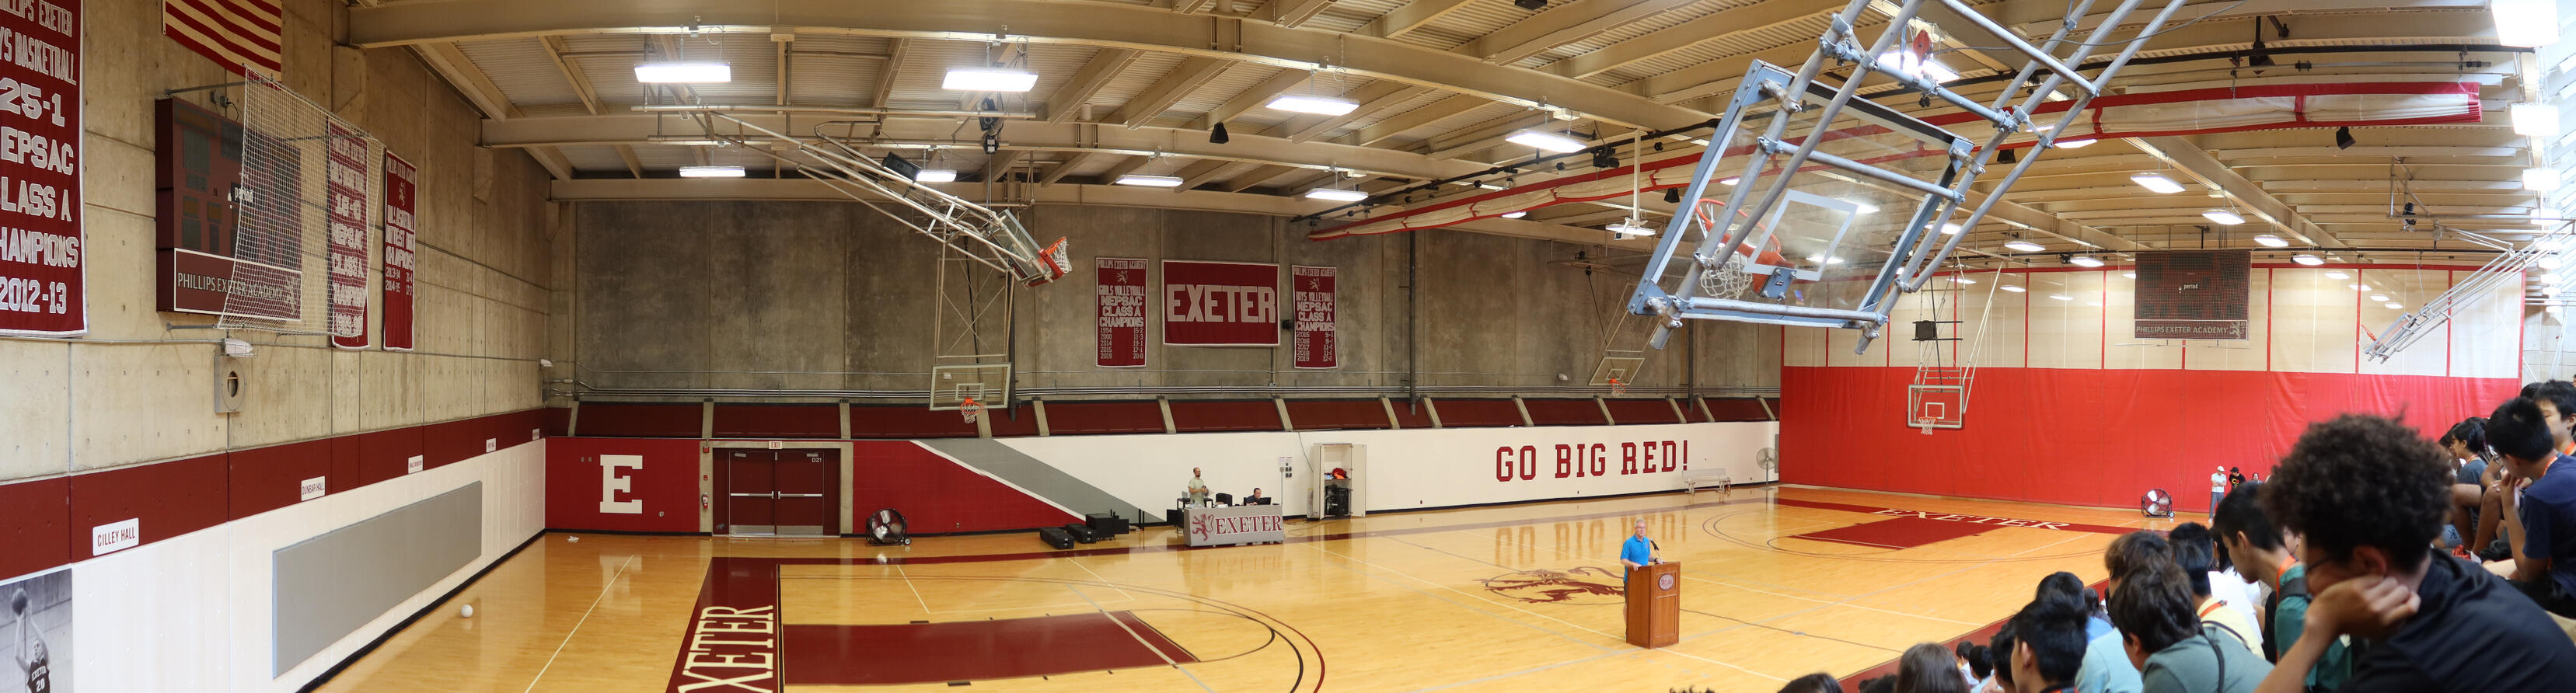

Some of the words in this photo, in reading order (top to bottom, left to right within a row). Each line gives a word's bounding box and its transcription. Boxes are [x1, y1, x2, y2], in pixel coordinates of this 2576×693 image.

[39, 0, 73, 37] EXETER
[16, 32, 77, 85] BASKETBALL
[0, 77, 65, 127] 25-1
[61, 189, 72, 221] A
[177, 272, 216, 292] PHILLIPS
[217, 277, 246, 295] EXETER
[0, 277, 67, 314] 2012-13
[1101, 295, 1143, 306] NEPSAC
[1167, 284, 1276, 324] EXETER
[1297, 301, 1333, 312] NEPSAC
[1099, 316, 1144, 327] CHAMPIONS
[1102, 306, 1134, 317] CLASS
[1134, 306, 1141, 317] A
[1298, 312, 1325, 322] CLASS
[1326, 312, 1332, 322] A
[1296, 321, 1335, 332] CHAMPIONS
[1496, 445, 1536, 482] GO
[1555, 443, 1606, 479] BIG
[1621, 440, 1688, 475] RED!
[600, 454, 643, 514] E
[1215, 515, 1283, 535] EXETER
[1873, 509, 2071, 530] EXETER
[97, 530, 120, 547] CILLEY
[120, 526, 136, 542] HALL
[677, 605, 774, 693] XETER
[36, 677, 45, 692] 20
